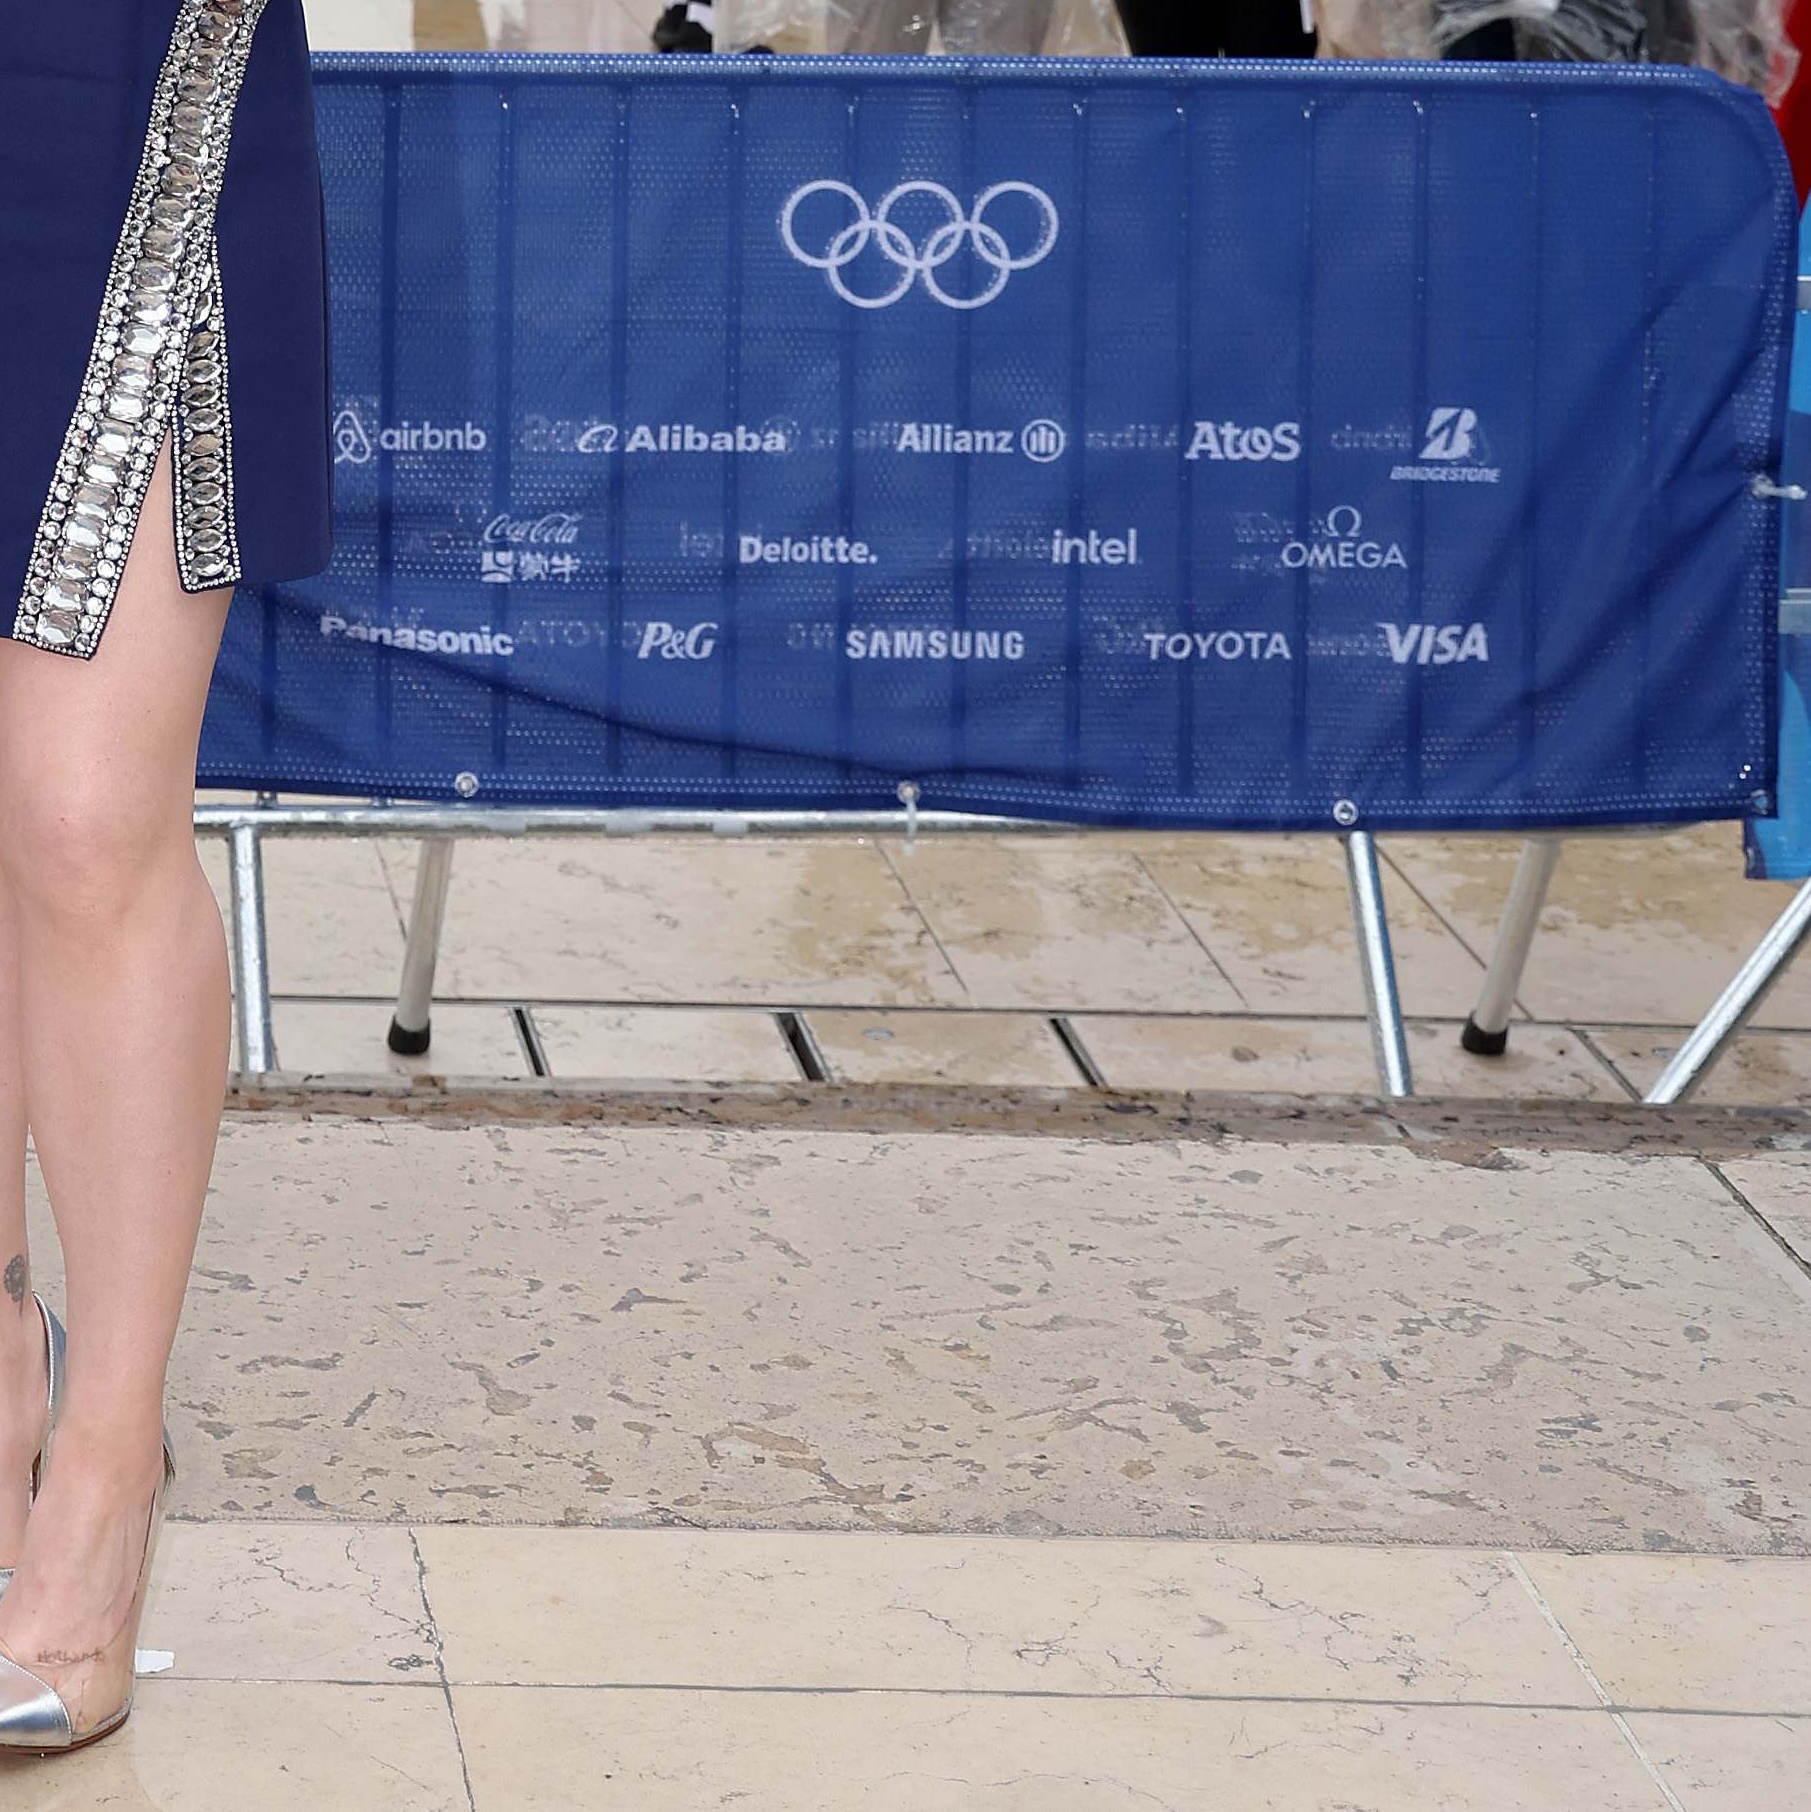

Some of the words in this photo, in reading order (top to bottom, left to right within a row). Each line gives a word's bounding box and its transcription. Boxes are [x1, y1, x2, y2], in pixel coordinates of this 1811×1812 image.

[379, 420, 487, 452] airbnb
[624, 424, 787, 453] Alibaba
[896, 422, 1014, 454] Allianz
[1390, 465, 1501, 483] BRIDGESTONE
[1052, 527, 1137, 565] intel
[1282, 541, 1408, 569] OMEGA
[320, 615, 515, 656] Panasonic
[637, 621, 718, 660] P&G
[846, 630, 1025, 660] SAMSUNG
[1144, 631, 1292, 661] TOYOTA
[1378, 622, 1488, 665] VISA
